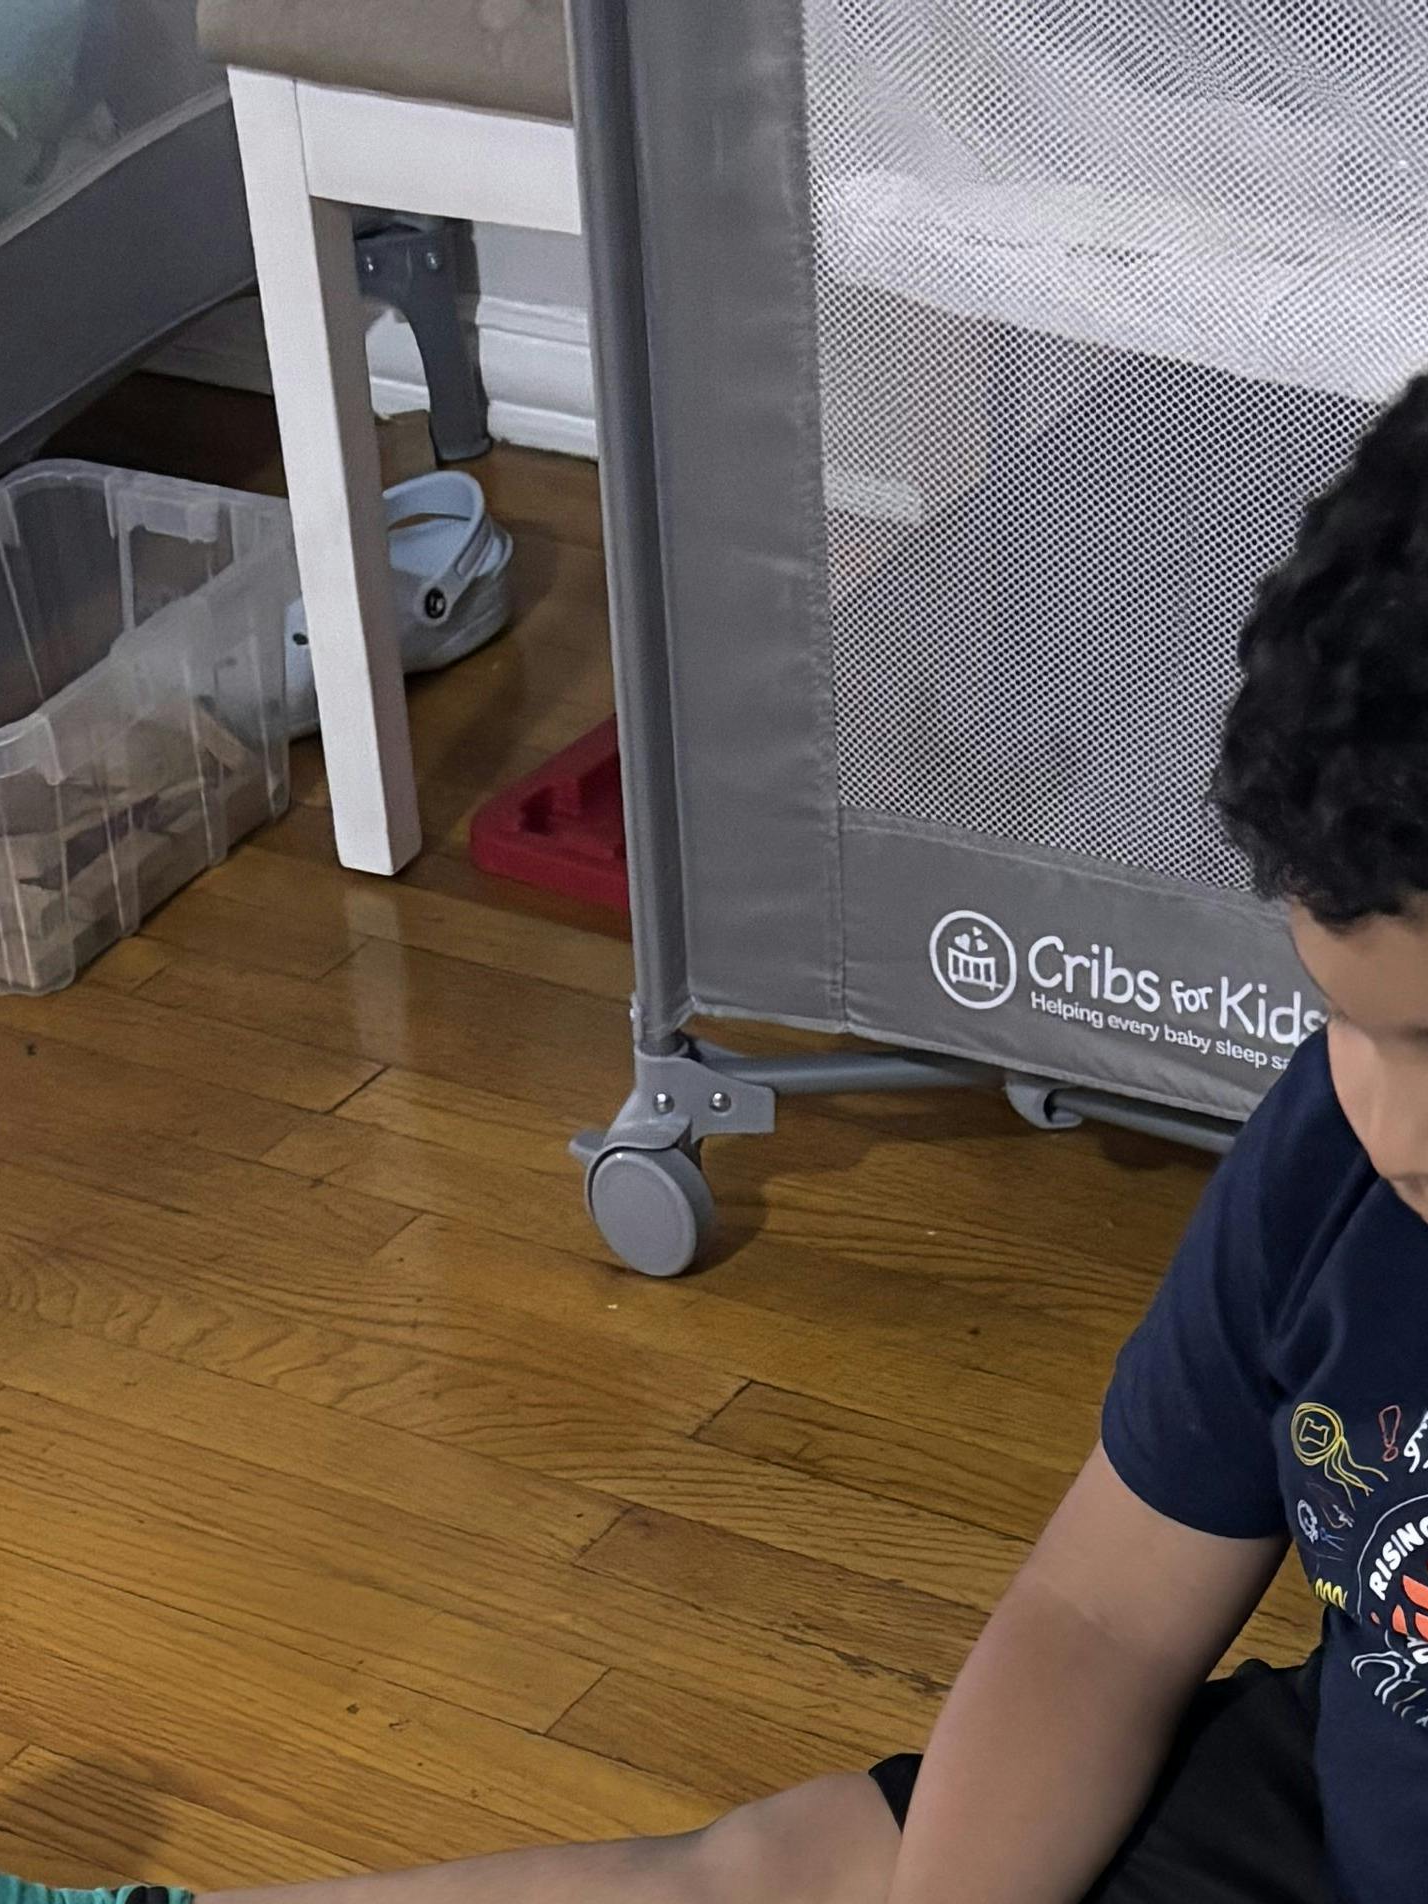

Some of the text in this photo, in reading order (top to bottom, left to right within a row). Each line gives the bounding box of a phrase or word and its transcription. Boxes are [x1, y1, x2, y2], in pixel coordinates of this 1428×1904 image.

[1028, 935, 1328, 1047] Cribs for Kids
[1030, 991, 1104, 1028] Helping
[1107, 1014, 1159, 1042] every
[1164, 1023, 1212, 1054] baby
[1215, 1039, 1268, 1069] sleep
